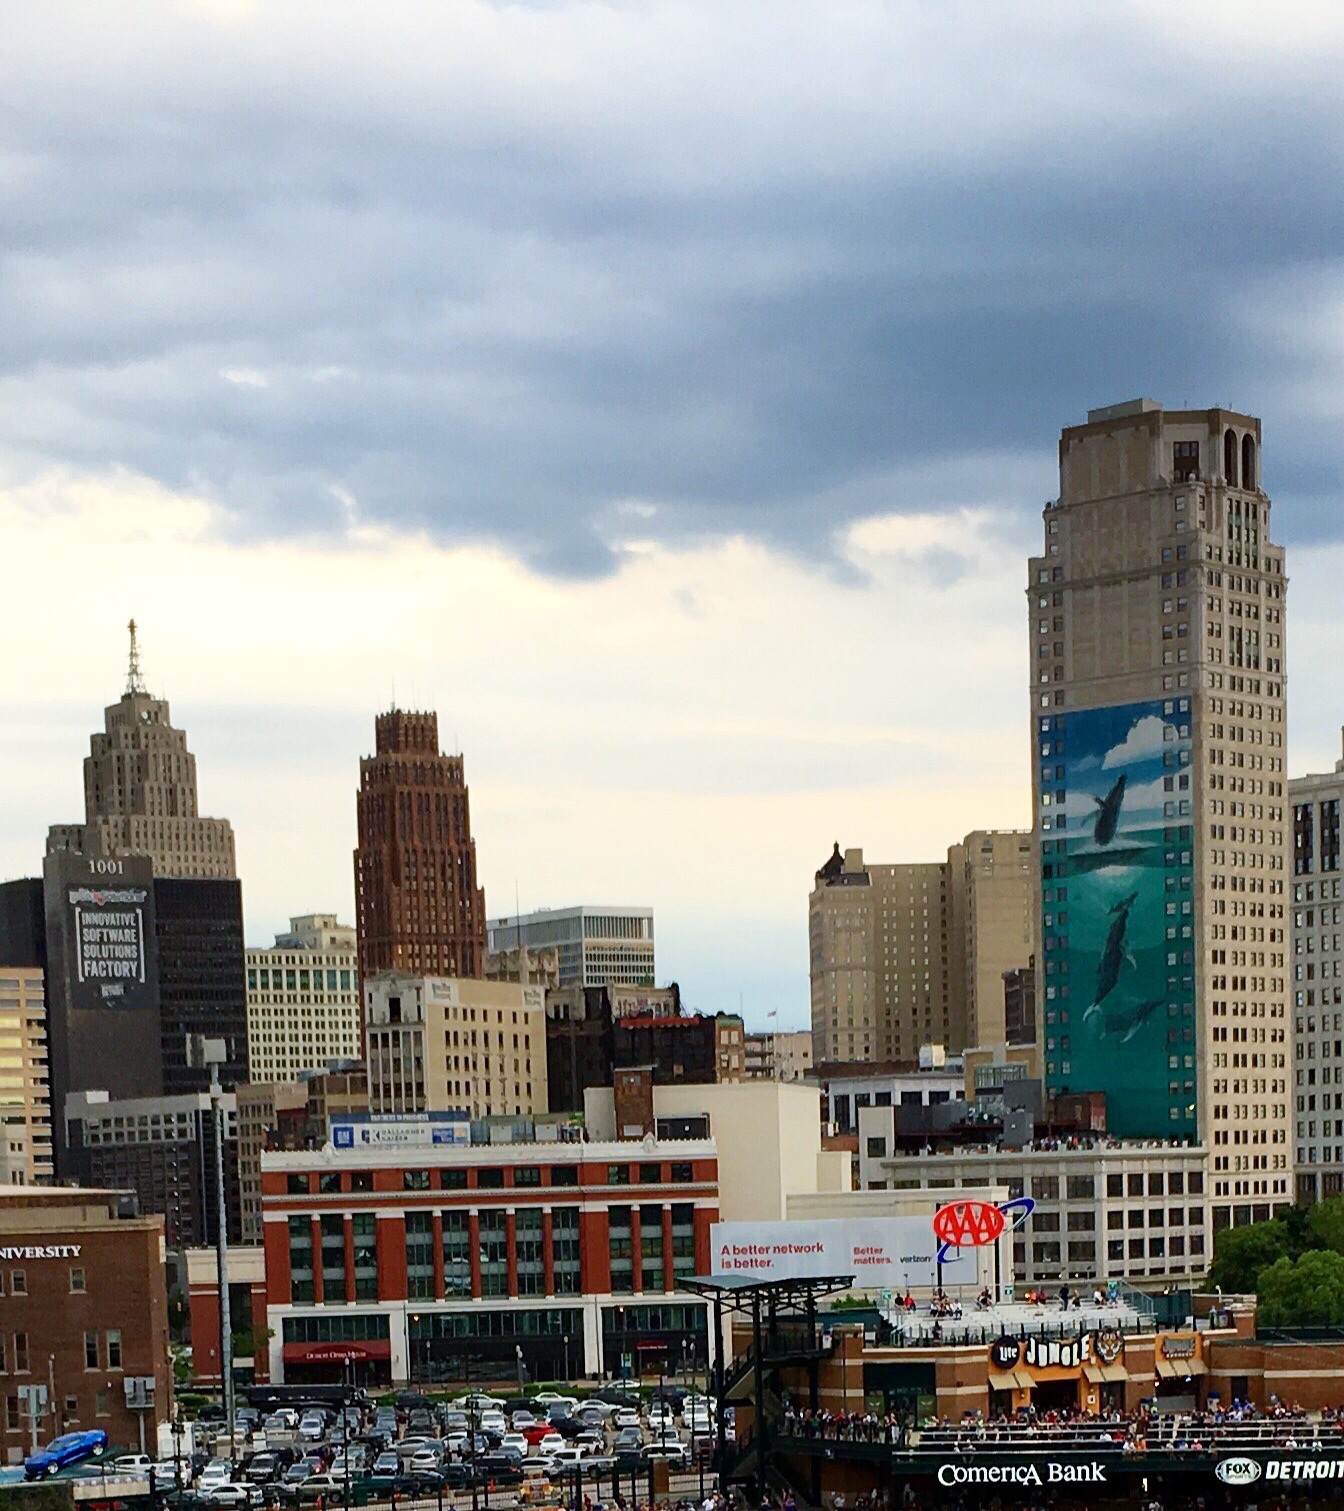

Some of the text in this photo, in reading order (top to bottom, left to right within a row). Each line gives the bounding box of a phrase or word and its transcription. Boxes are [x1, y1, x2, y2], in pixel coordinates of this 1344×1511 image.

[89, 859, 123, 875] 1001
[81, 912, 136, 926] INNOVATIVE
[82, 928, 137, 942] SOFTWARE
[83, 944, 138, 959] SOLUTIONS
[84, 961, 138, 978] FACTORY
[937, 1202, 1002, 1245] AAA
[721, 1242, 825, 1255] A better network
[853, 1246, 884, 1256] Better
[721, 1257, 775, 1269] is better.
[853, 1256, 893, 1266] matters.
[1047, 1462, 1107, 1483] Bank
[1225, 1462, 1251, 1474] FOX
